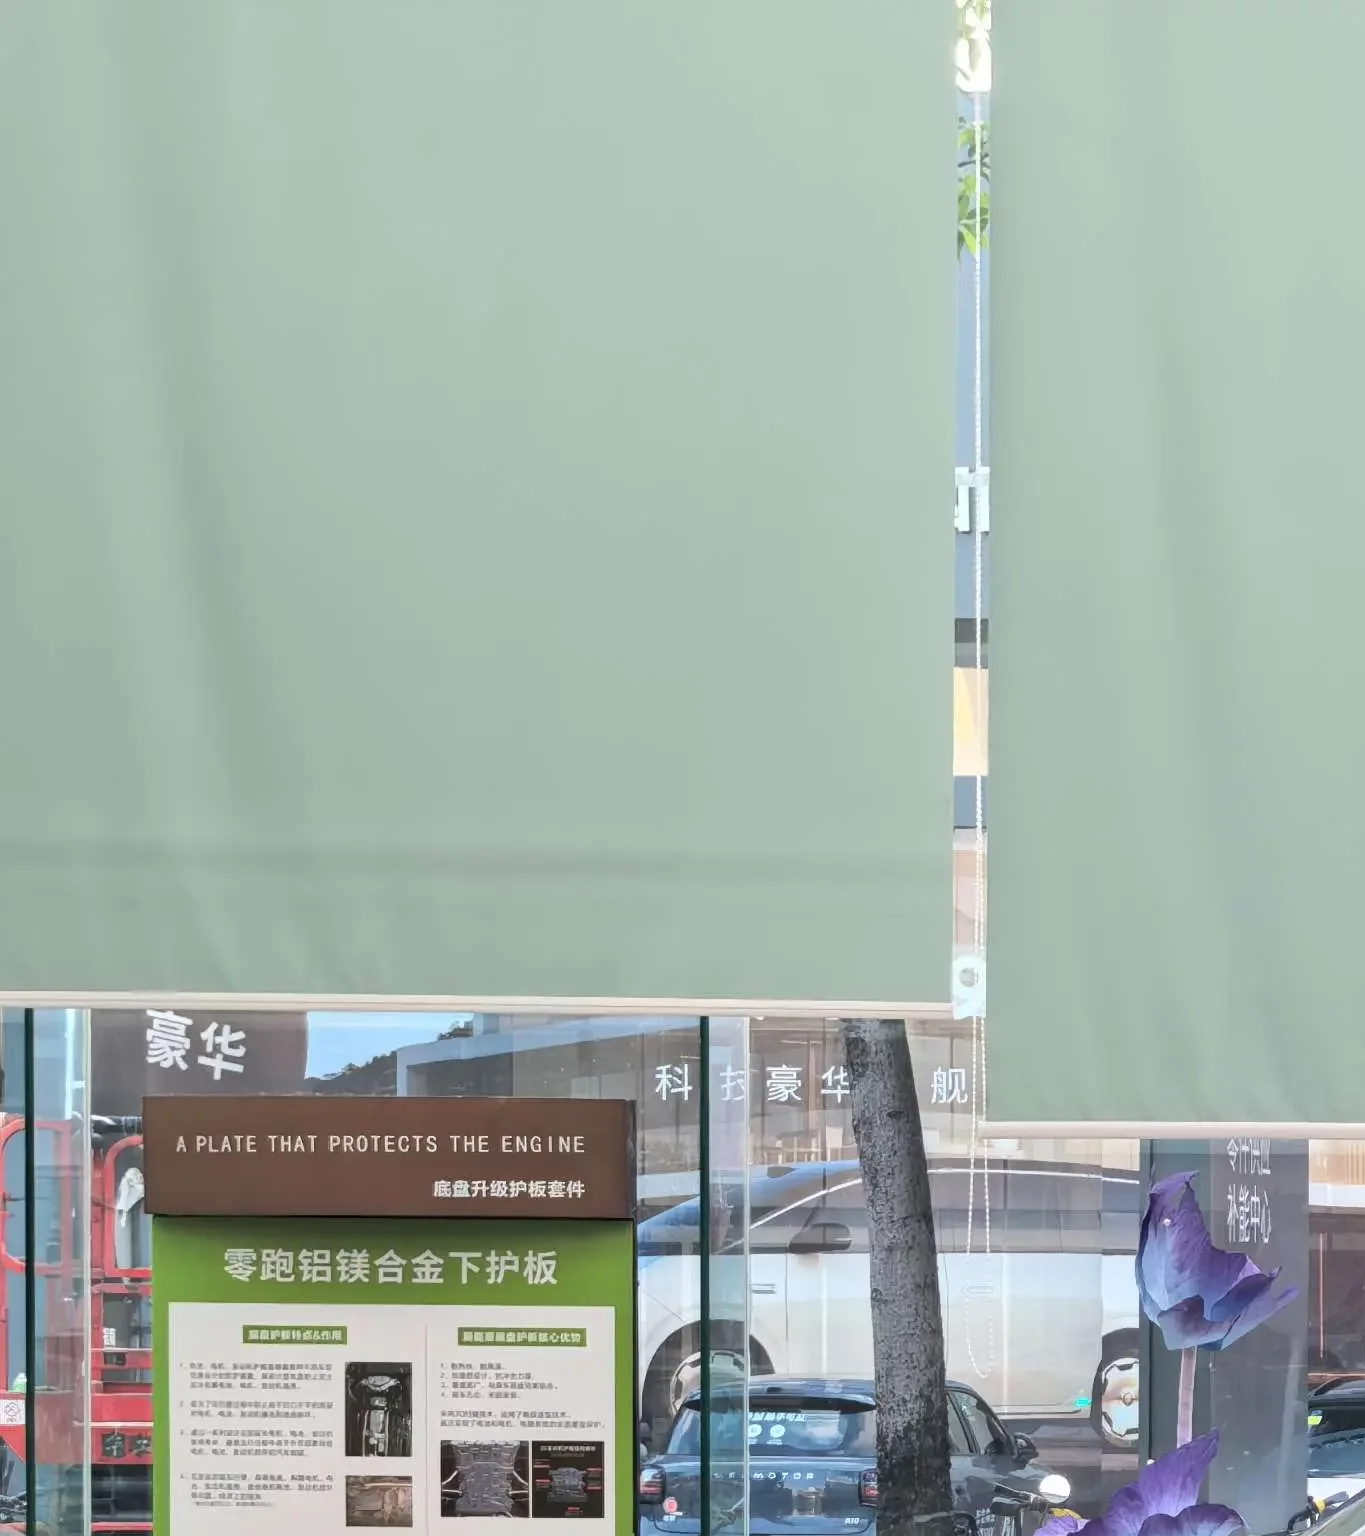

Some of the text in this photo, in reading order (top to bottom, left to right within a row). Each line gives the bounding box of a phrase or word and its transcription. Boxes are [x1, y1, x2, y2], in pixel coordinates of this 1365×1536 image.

[146, 1009, 247, 1081] 豪华
[176, 1135, 586, 1154] A PLATE THAT PROTECTS THE ENGINE
[433, 1180, 585, 1199] 底盘升级护板套件
[223, 1248, 558, 1285] 零跑铝镁合金下护板
